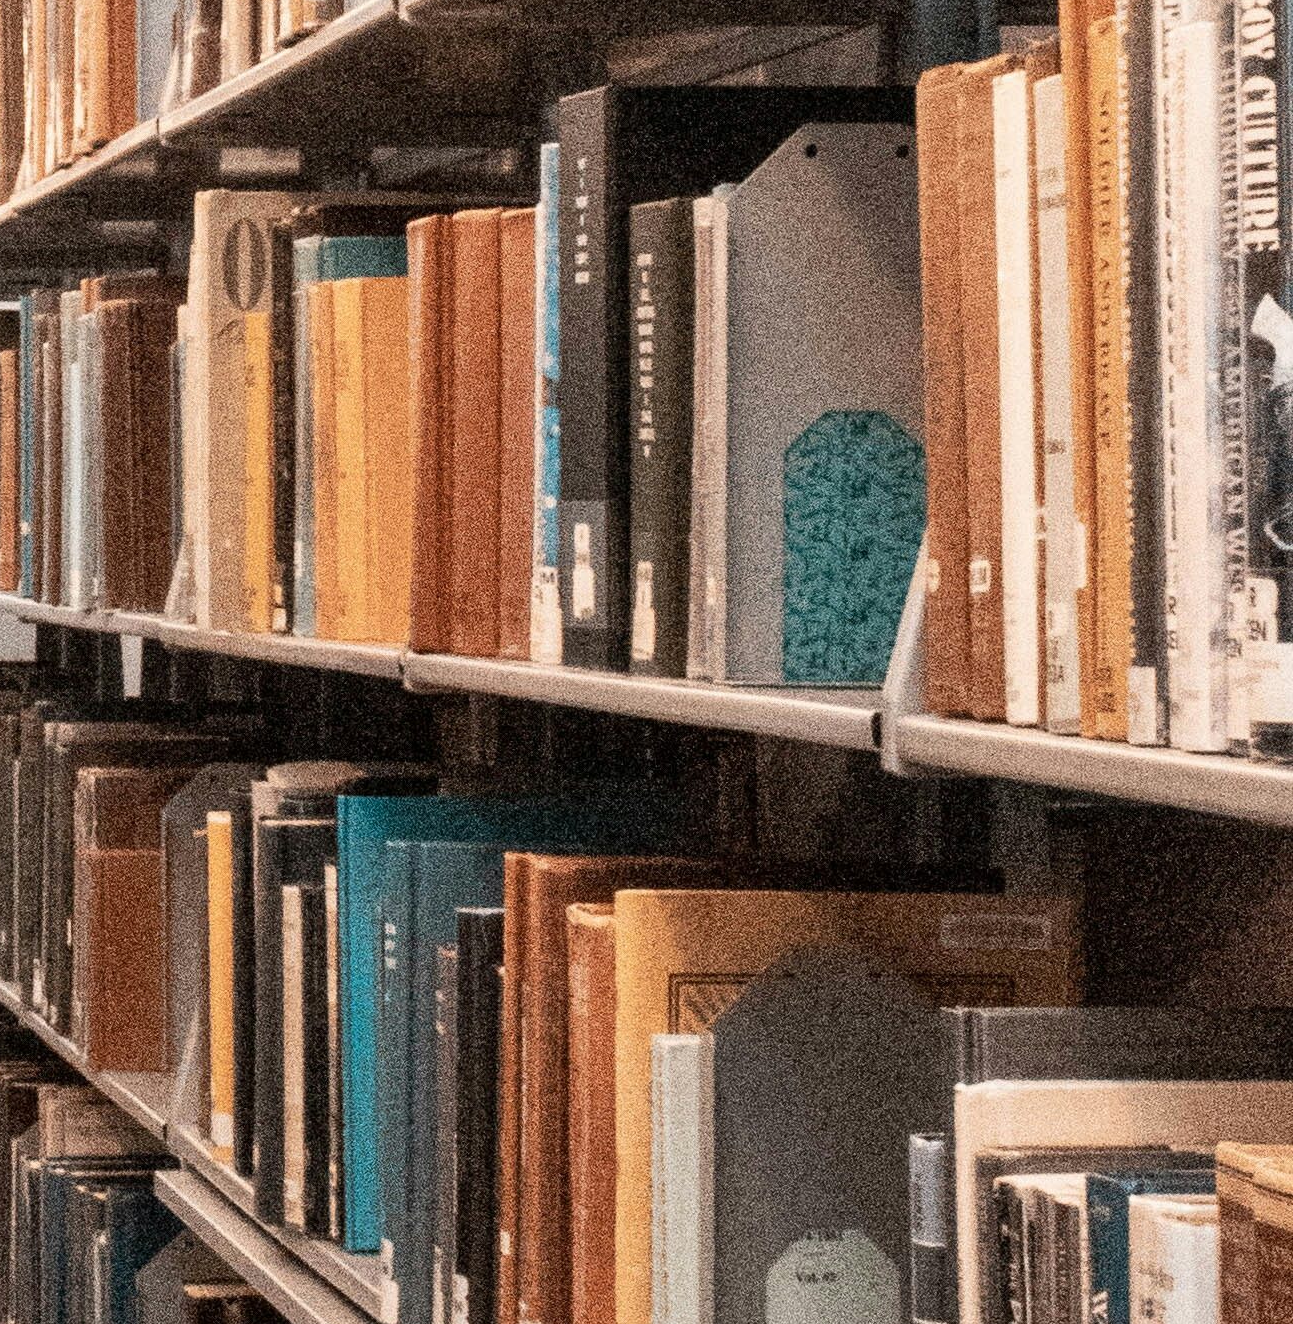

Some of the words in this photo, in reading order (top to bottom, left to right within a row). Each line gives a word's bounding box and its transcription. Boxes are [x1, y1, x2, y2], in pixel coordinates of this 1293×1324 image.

[1098, 88, 1113, 240] SOLDIER
[1240, 74, 1281, 256] CULTURE
[1099, 255, 1112, 330] AND
[1224, 344, 1245, 516] AMERICAN
